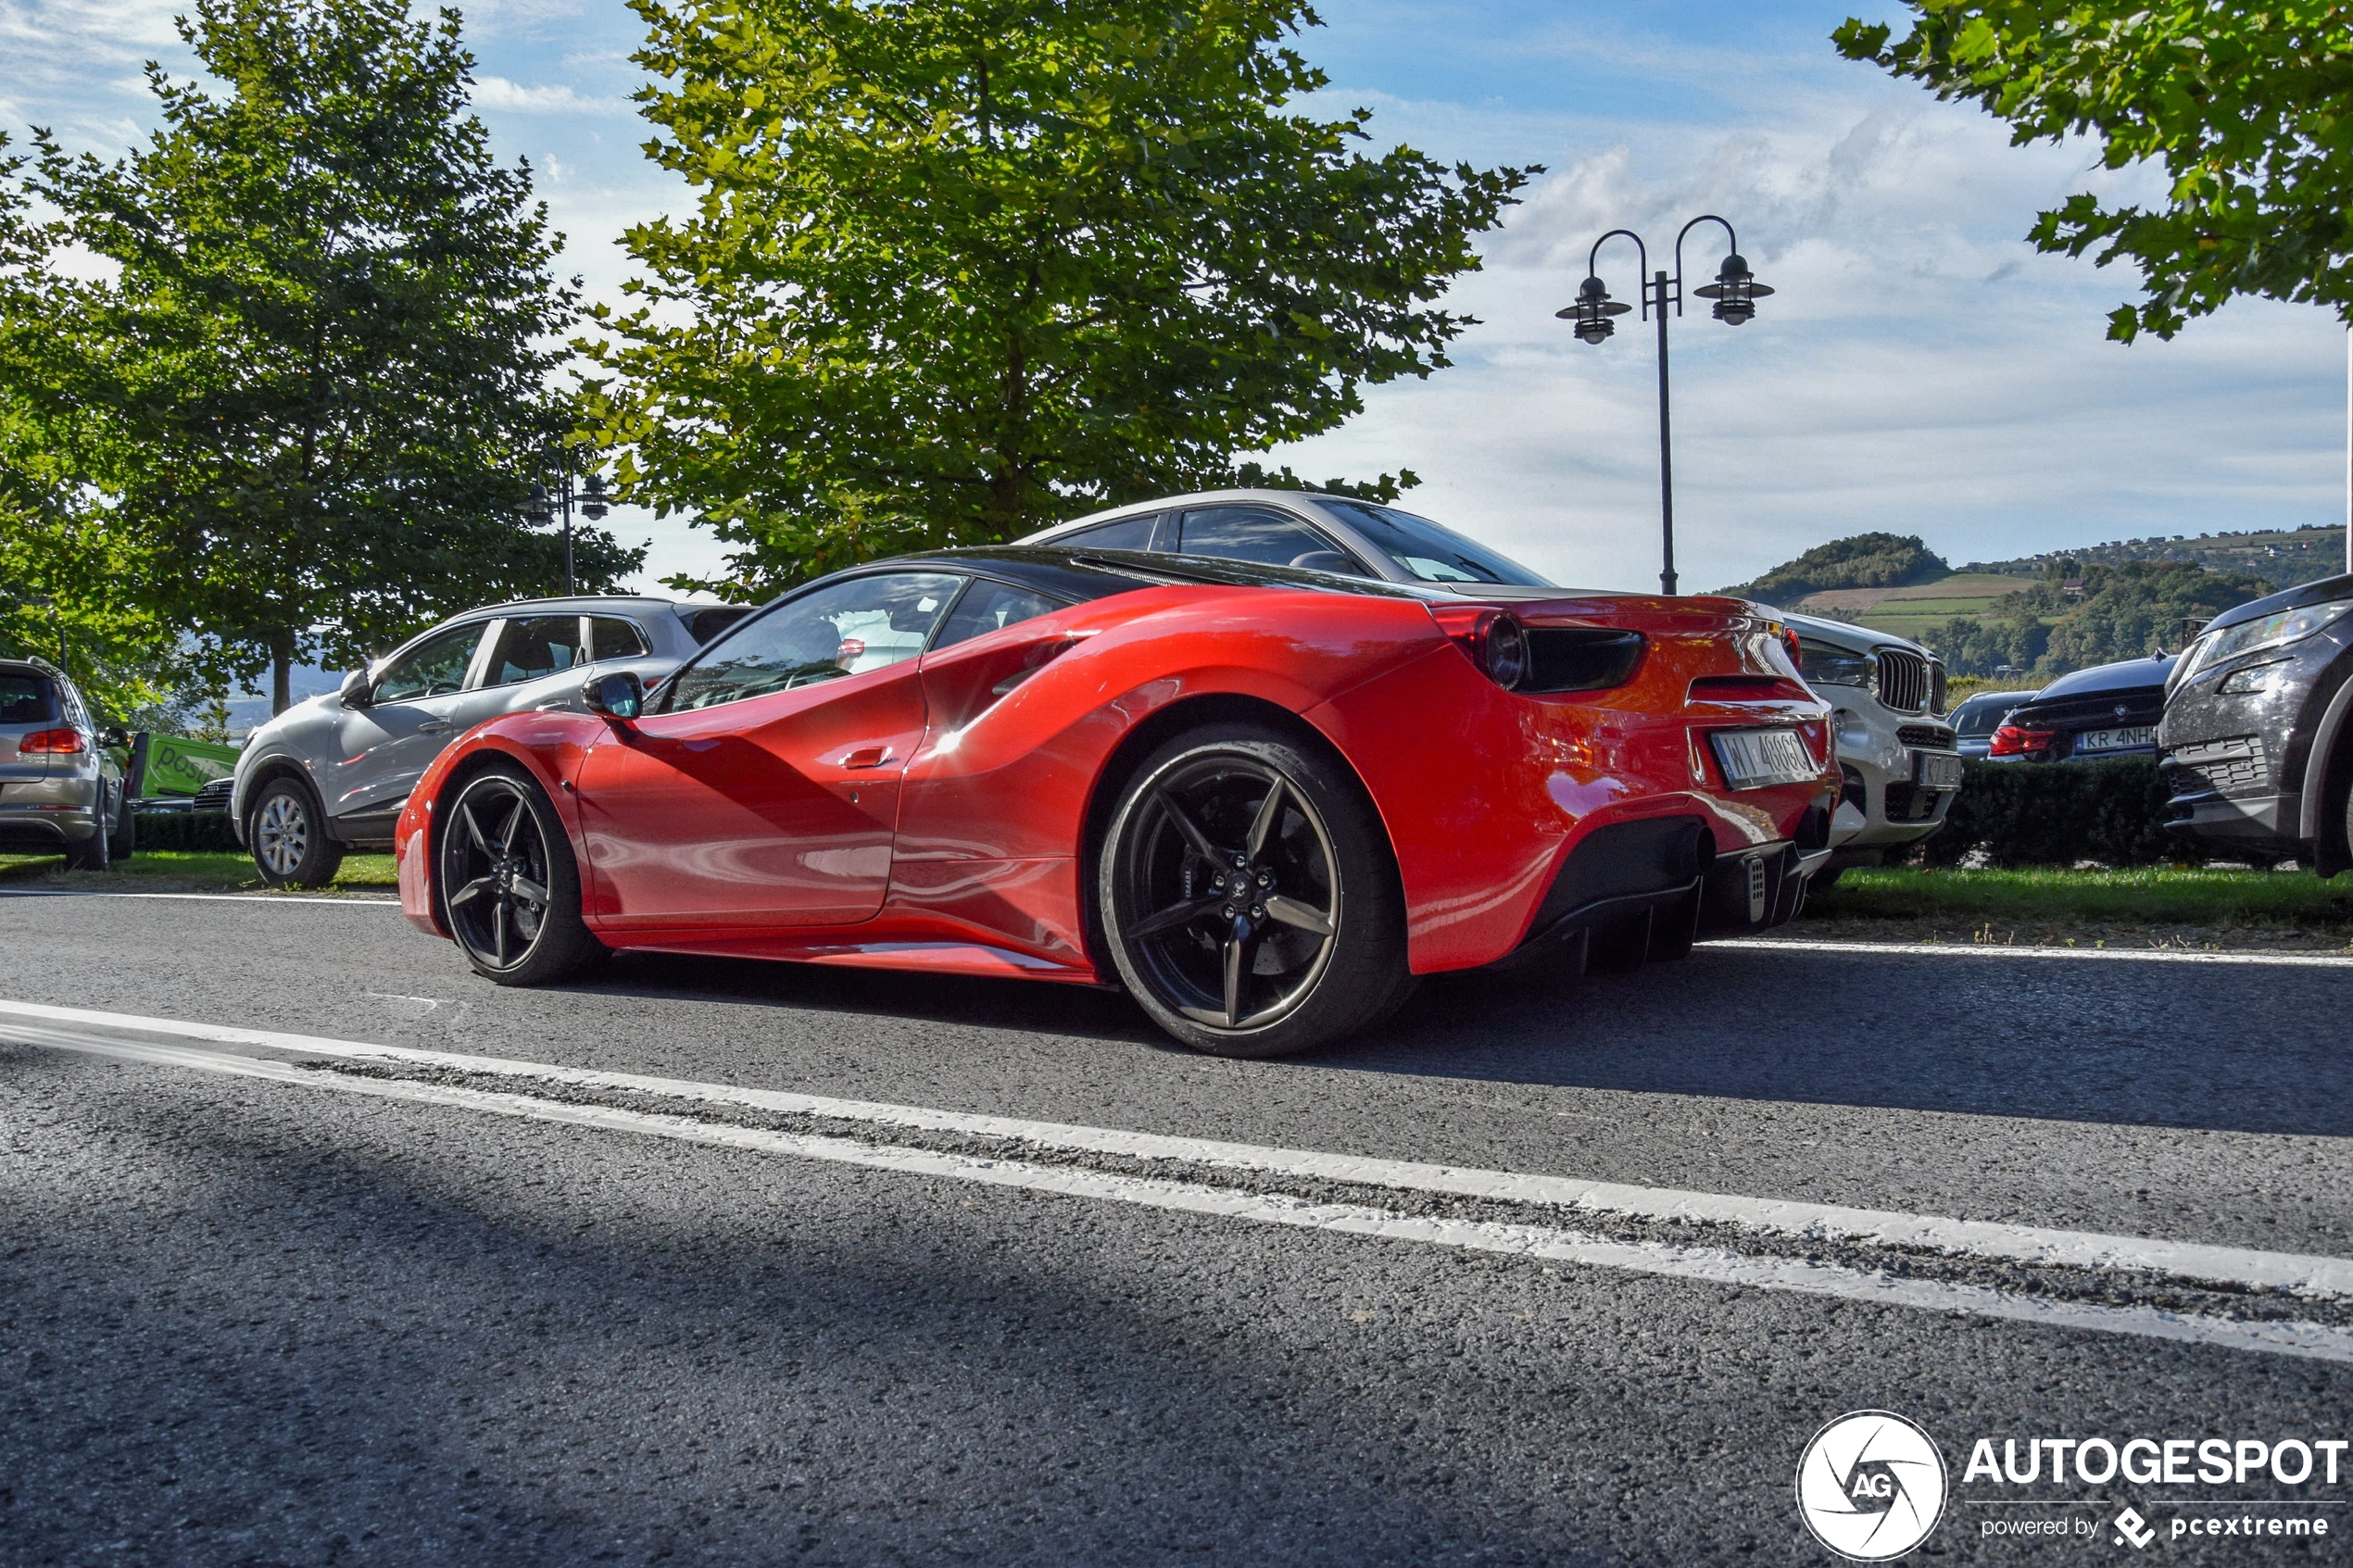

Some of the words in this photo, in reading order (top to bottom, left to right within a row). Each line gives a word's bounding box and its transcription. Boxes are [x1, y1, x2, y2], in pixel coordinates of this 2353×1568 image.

[2086, 732, 2108, 747] KR
[1724, 736, 1757, 777] WI
[1759, 734, 1807, 772] 488GC
